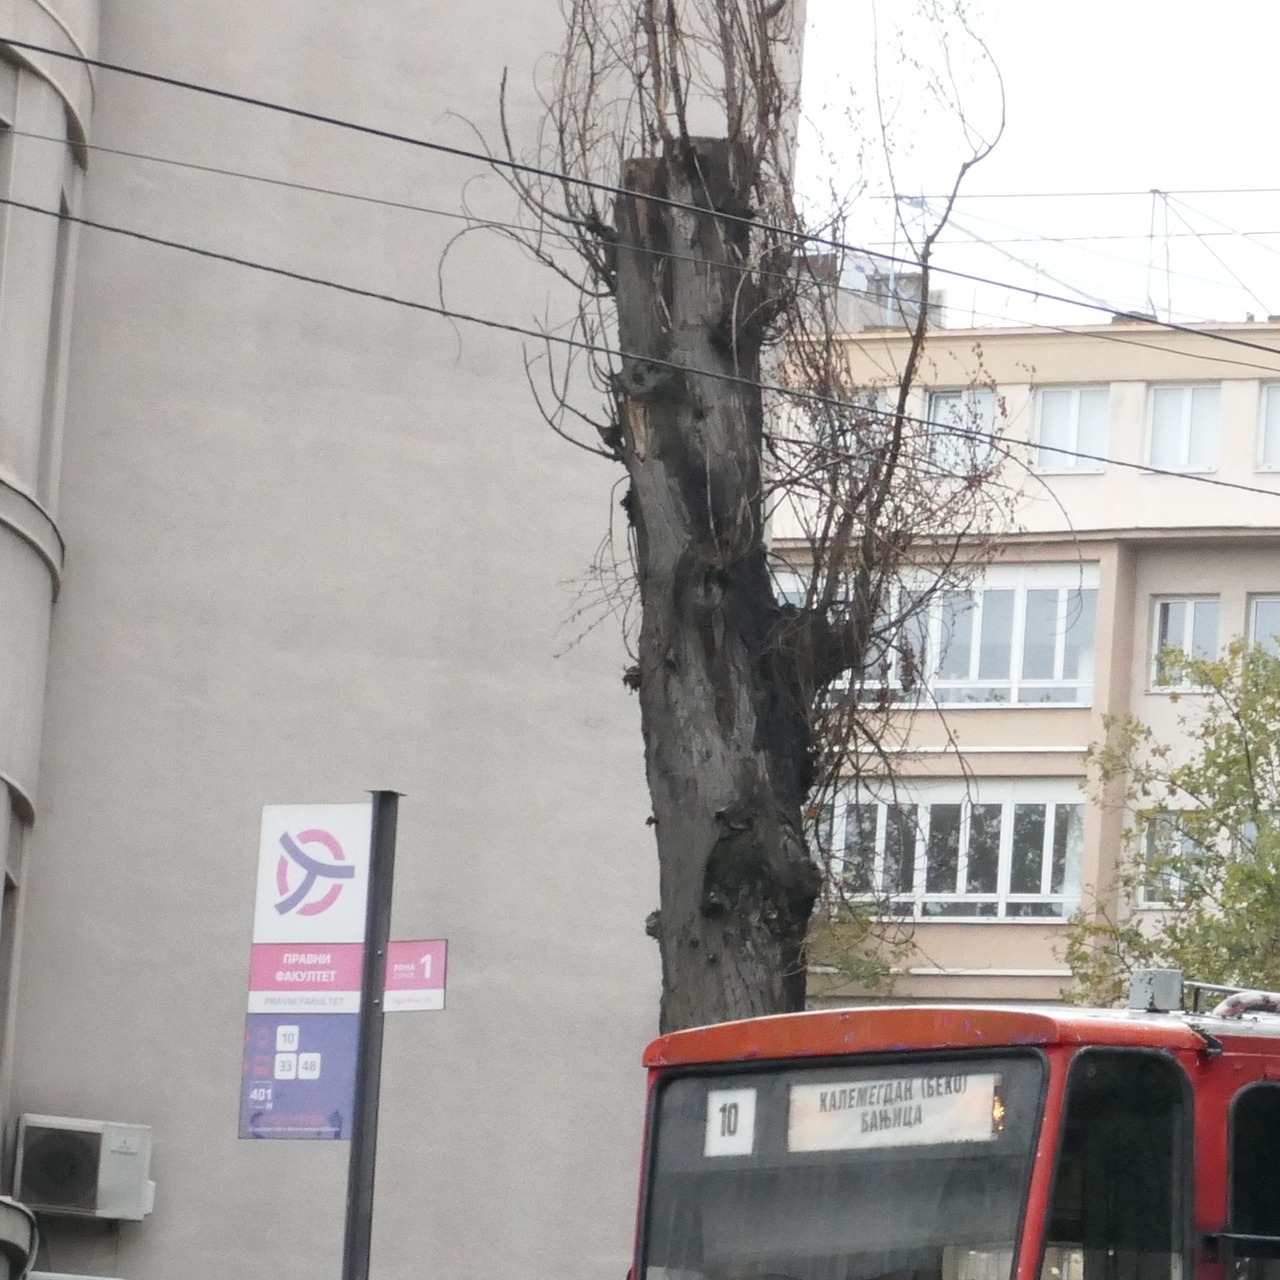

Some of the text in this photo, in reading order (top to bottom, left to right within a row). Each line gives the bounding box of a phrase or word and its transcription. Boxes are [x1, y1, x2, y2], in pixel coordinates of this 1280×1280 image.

[283, 953, 331, 965] ПРАВНИ
[420, 954, 432, 979] 1
[275, 970, 337, 982] ФАКУЛТЕТ
[282, 1032, 295, 1044] 10
[279, 1060, 317, 1072] 33 48
[249, 1088, 272, 1101] 401
[819, 1078, 914, 1113] КАЛЕМЕГДАН
[718, 1102, 739, 1137] 10
[860, 1104, 923, 1133] БАЊИЦА
